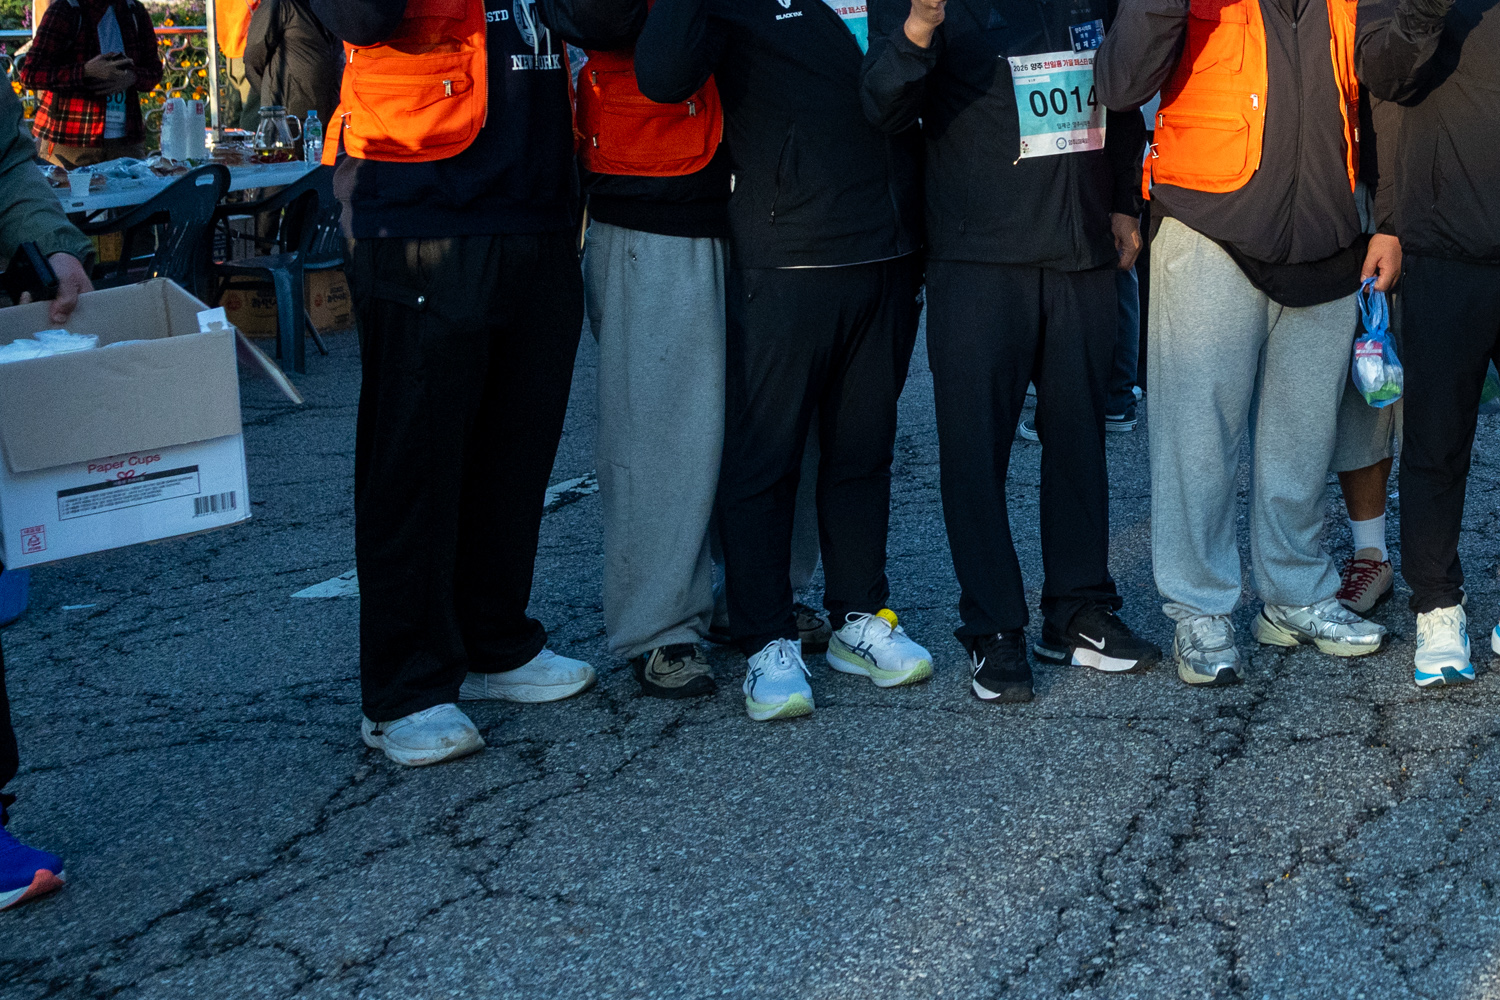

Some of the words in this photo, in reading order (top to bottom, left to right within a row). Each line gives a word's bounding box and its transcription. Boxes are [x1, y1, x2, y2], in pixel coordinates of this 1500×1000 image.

[485, 9, 509, 22] STD
[1013, 64, 1029, 72] 2026
[1030, 62, 1043, 71] 양주
[1029, 85, 1099, 118] 0014
[87, 459, 125, 475] Paper
[128, 452, 161, 467] Cups
